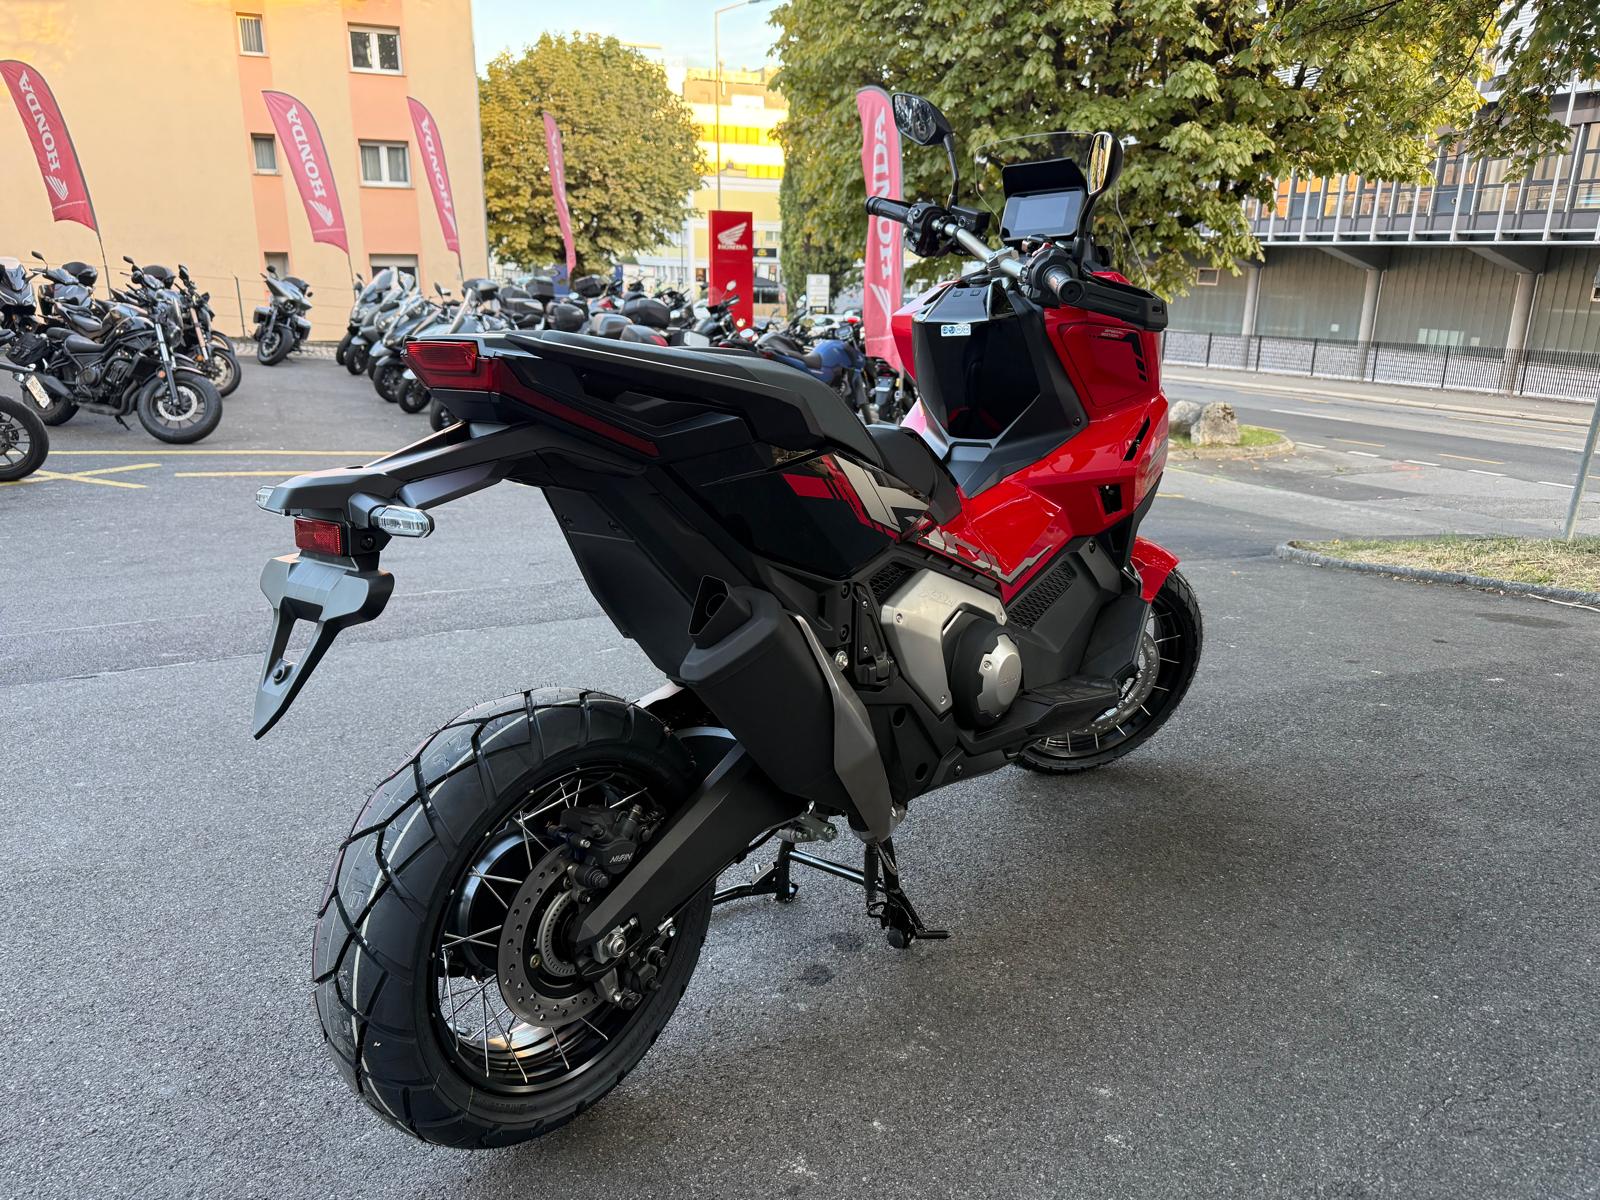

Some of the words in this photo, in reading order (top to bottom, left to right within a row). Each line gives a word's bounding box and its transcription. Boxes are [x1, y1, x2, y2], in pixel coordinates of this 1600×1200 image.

[18, 70, 61, 172] HONDA
[286, 104, 327, 198] HONDA
[421, 114, 452, 209] HONDA
[873, 106, 892, 280] HONDA
[717, 243, 748, 251] HONDA
